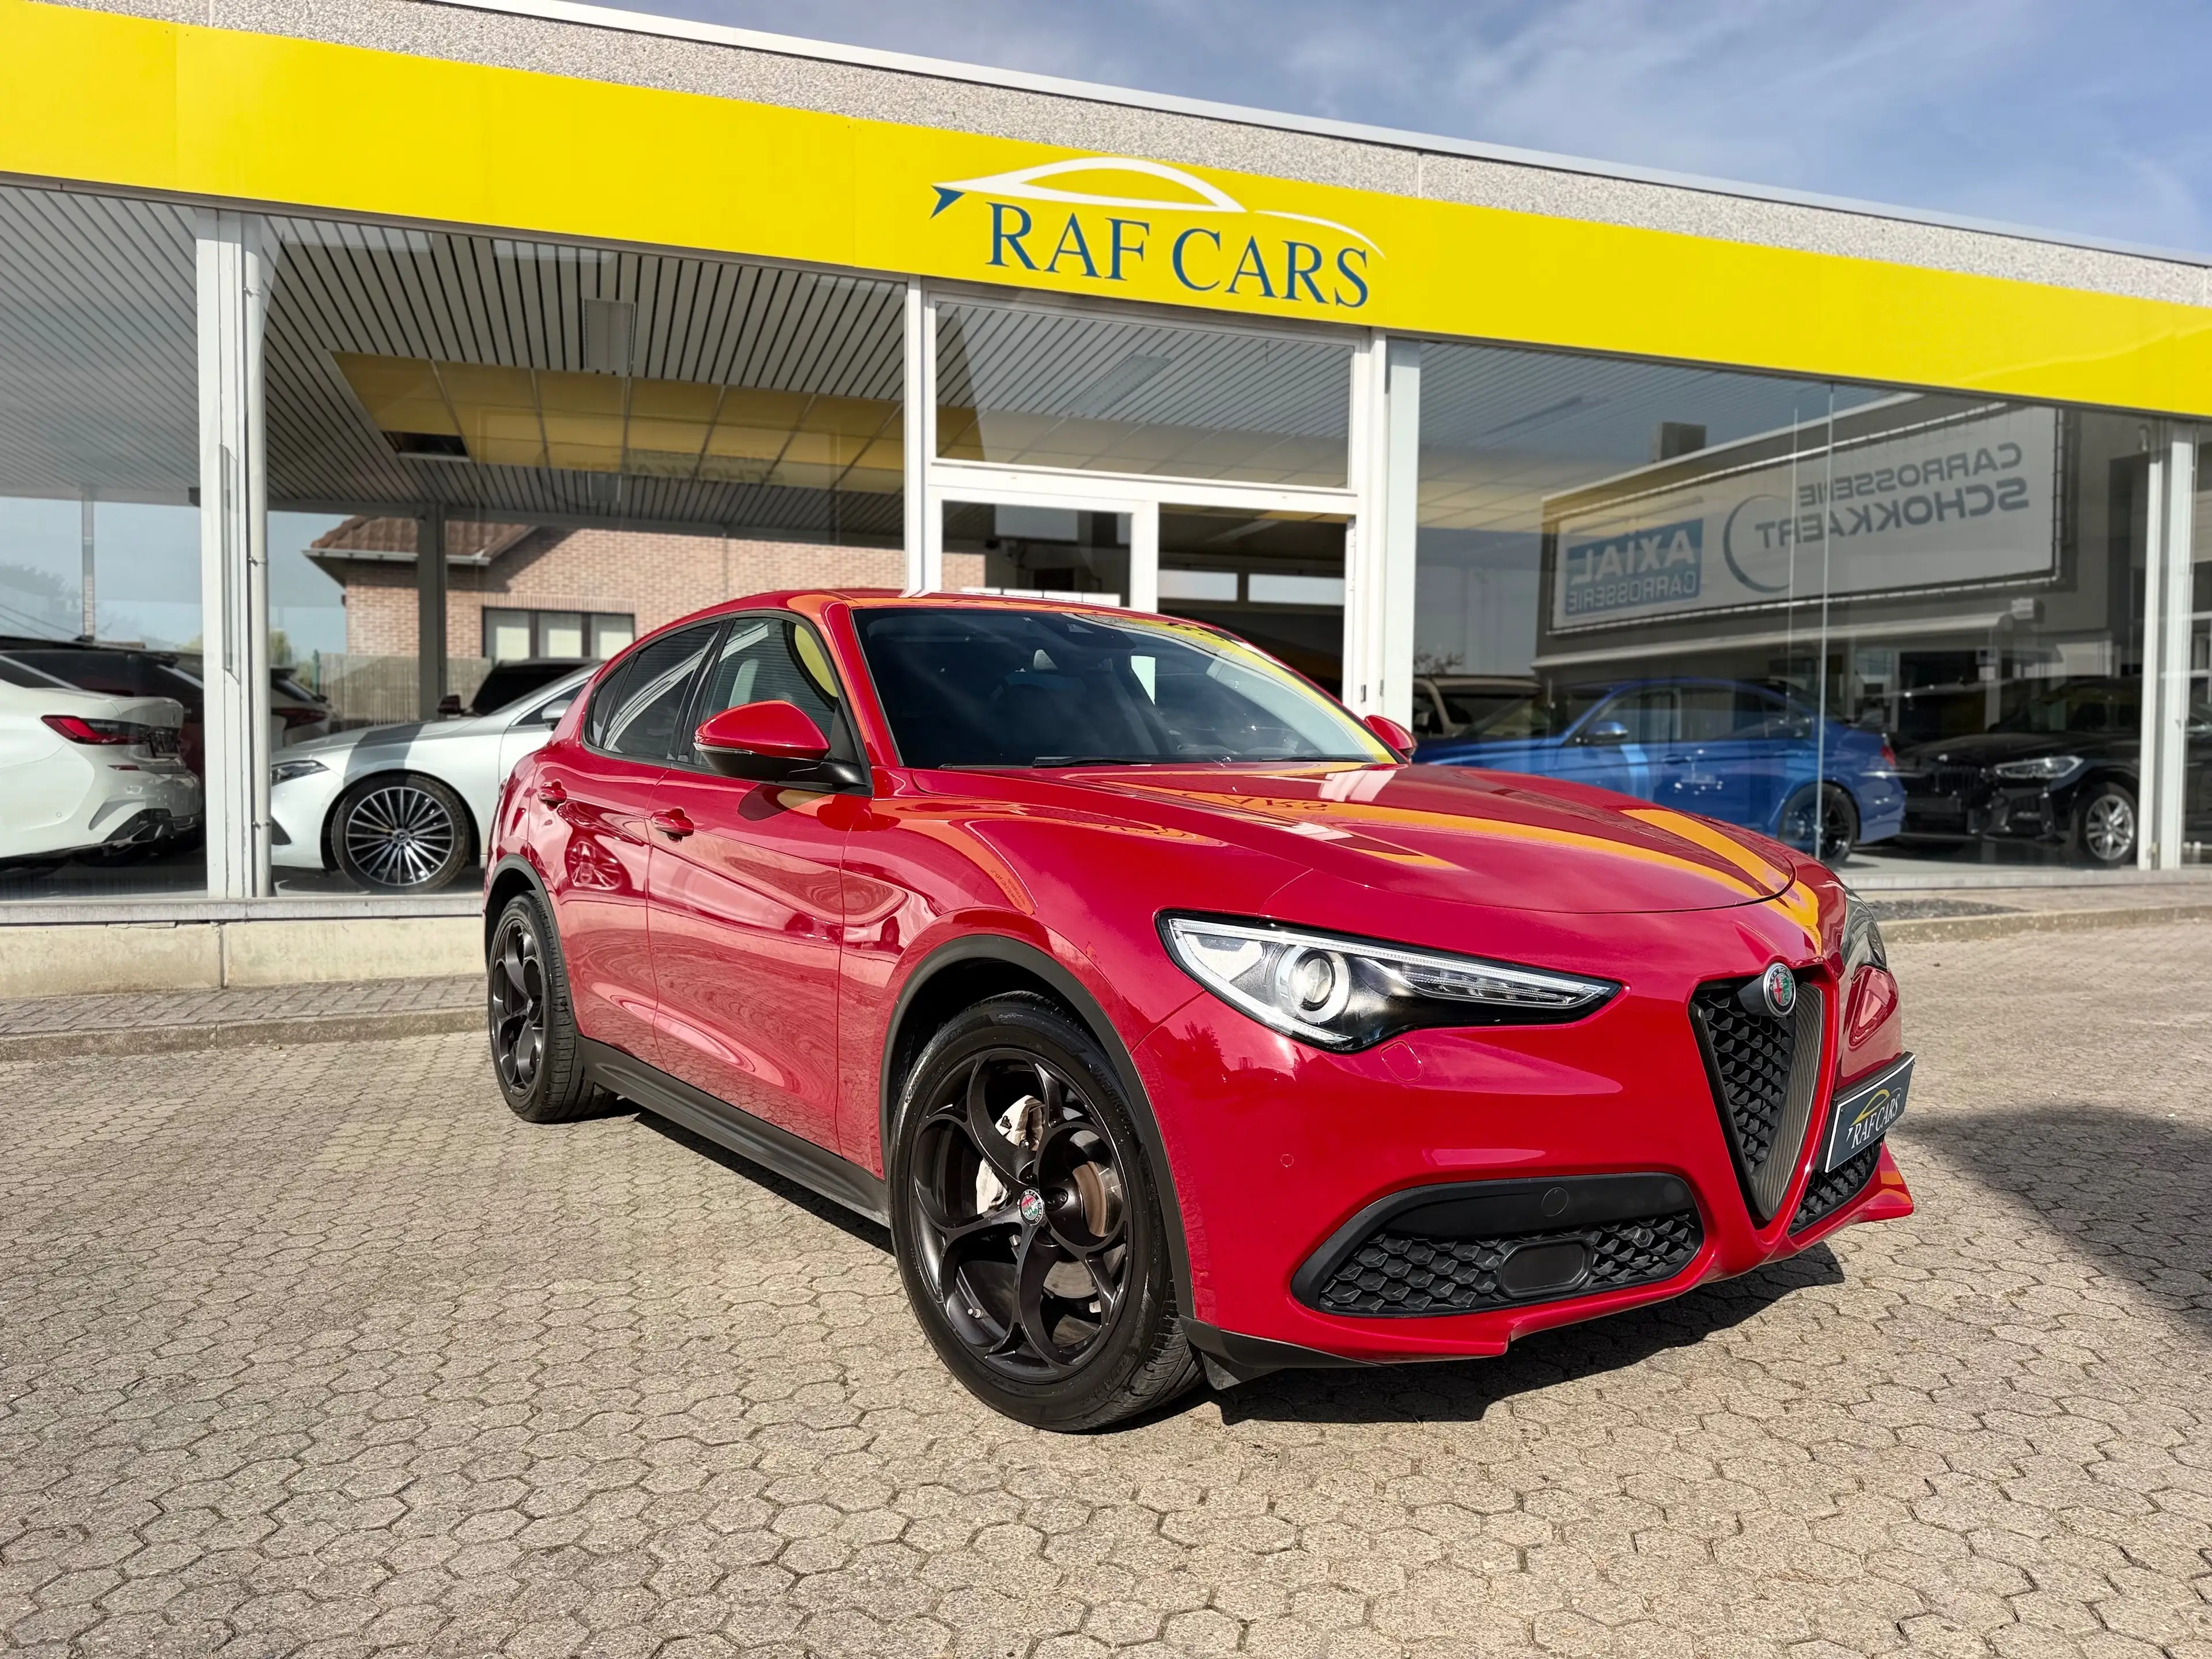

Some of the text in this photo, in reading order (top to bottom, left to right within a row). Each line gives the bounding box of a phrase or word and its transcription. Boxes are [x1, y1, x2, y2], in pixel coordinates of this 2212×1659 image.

[985, 202, 1369, 308] RAF CARS
[1770, 972, 1778, 991] ALFA
[1851, 1093, 1900, 1149] RAF CARS
